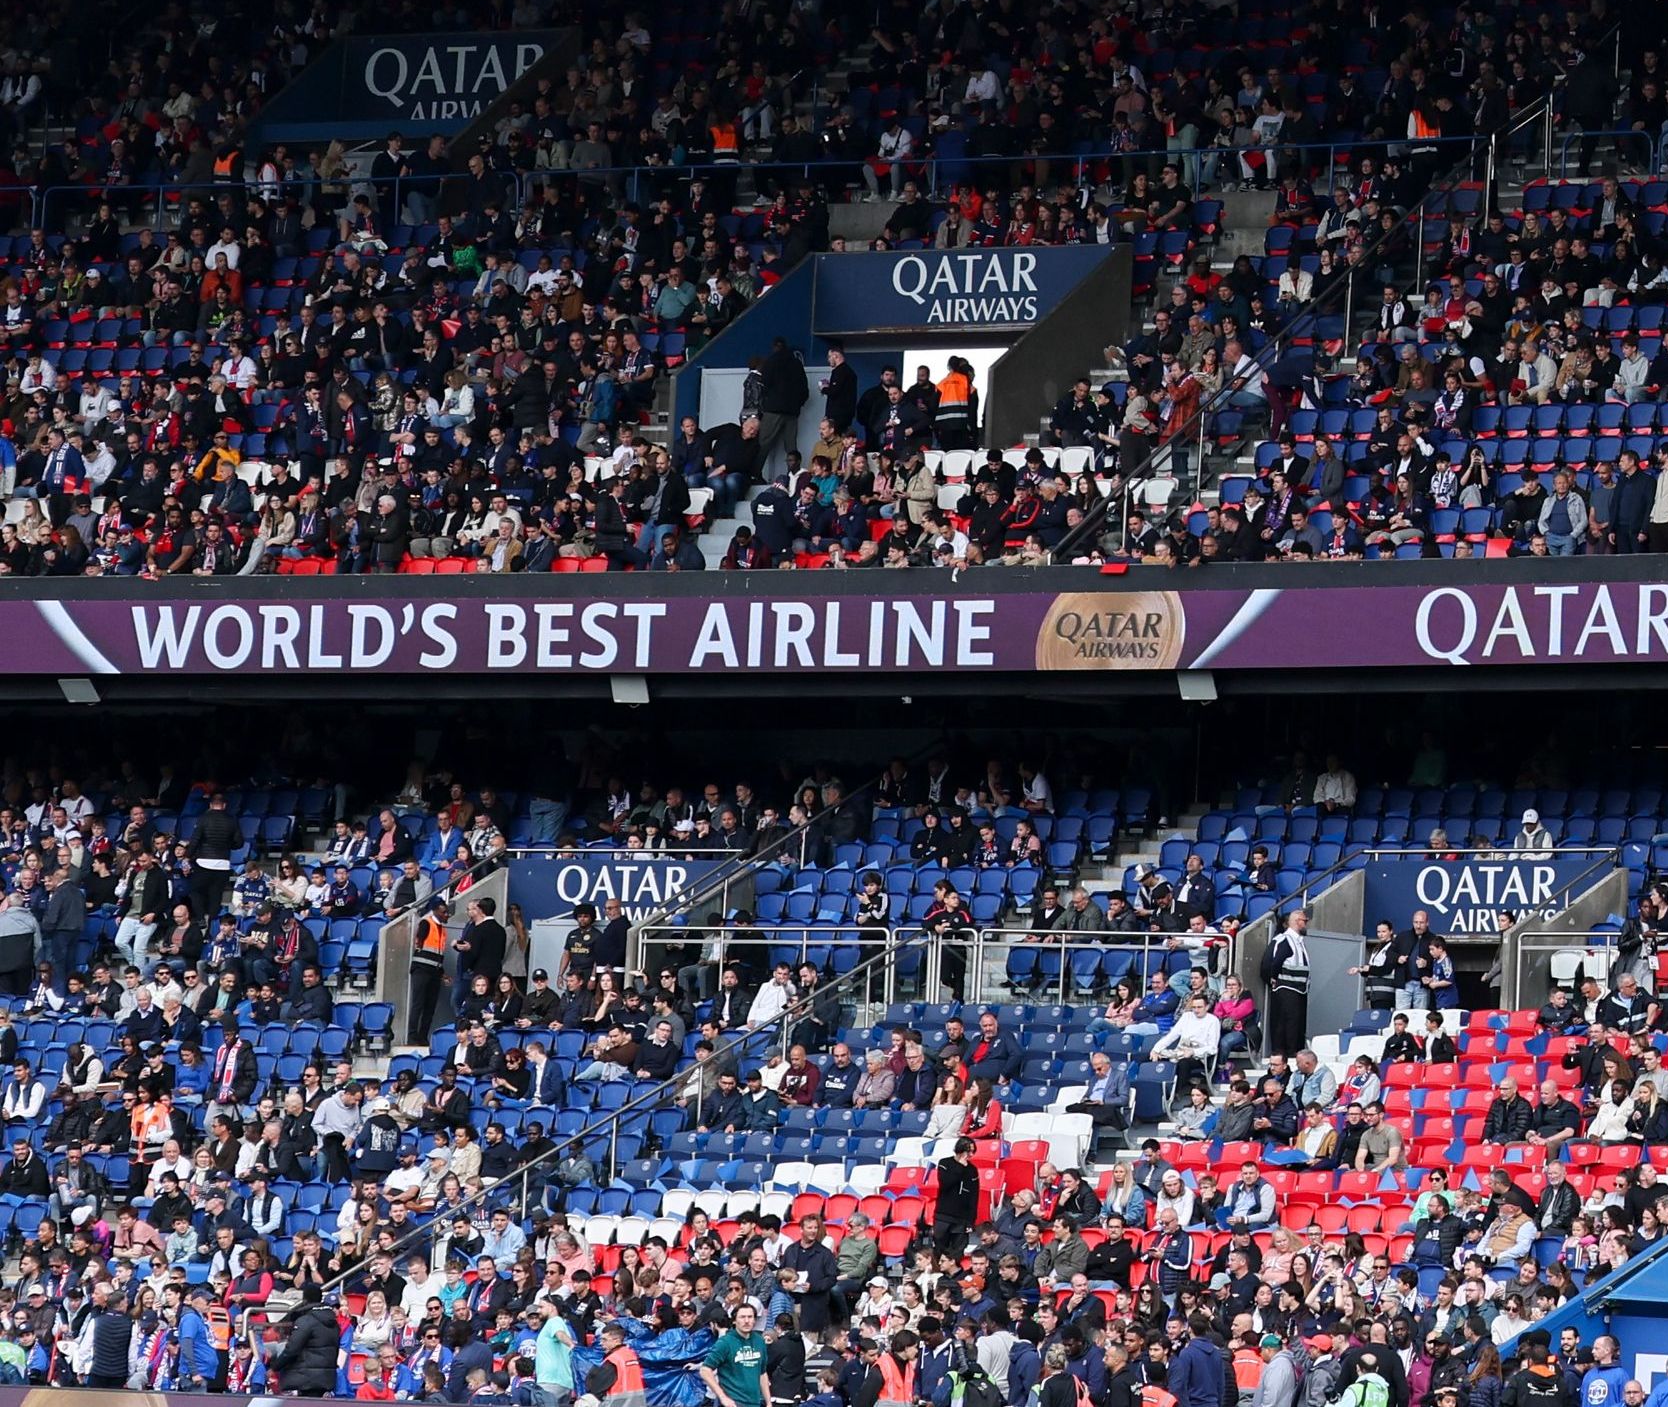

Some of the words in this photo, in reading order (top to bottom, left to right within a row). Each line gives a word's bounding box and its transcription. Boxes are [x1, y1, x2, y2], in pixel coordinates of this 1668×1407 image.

[892, 253, 1038, 304] QATAR
[927, 296, 1037, 323] AIRWAYS
[132, 602, 457, 669] WORLD'S
[485, 601, 666, 668] BEST
[689, 599, 995, 668] AIRLINE
[1056, 612, 1163, 645] QATAR
[1078, 641, 1159, 659] AIRWAYS
[557, 864, 687, 905] QATAR
[1416, 865, 1557, 914] QATAR
